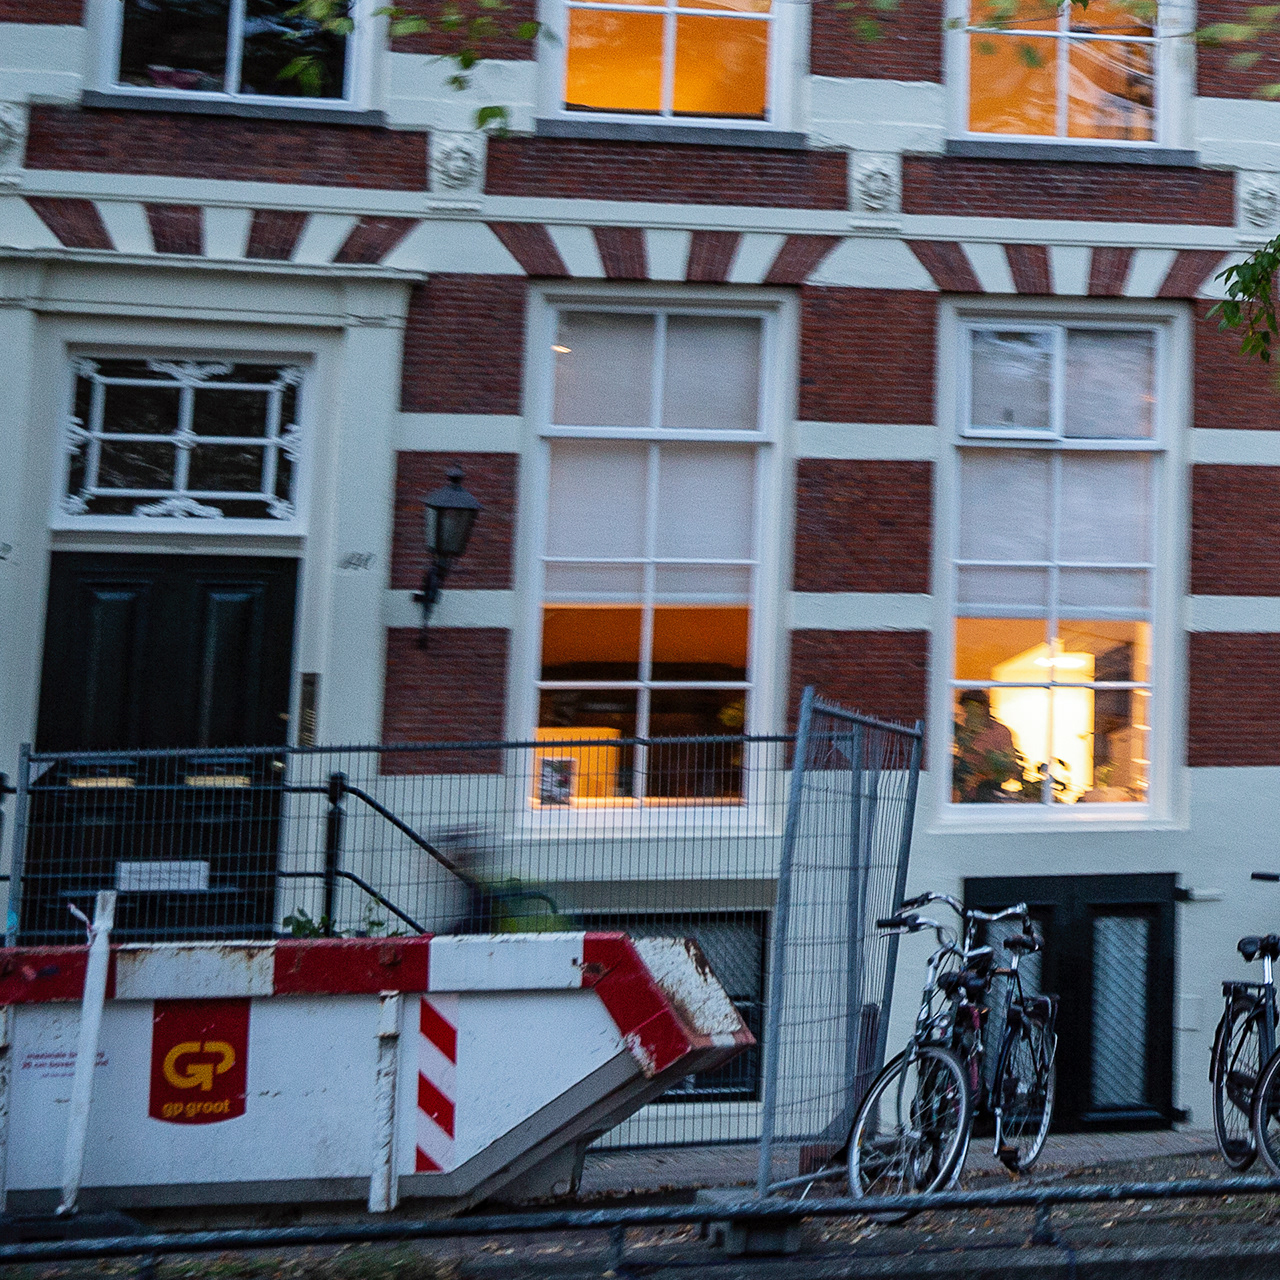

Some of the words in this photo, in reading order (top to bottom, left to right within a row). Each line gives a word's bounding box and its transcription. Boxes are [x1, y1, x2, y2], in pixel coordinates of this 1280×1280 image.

[163, 1040, 236, 1092] GP
[161, 1101, 184, 1118] gp
[185, 1098, 231, 1118] groot
